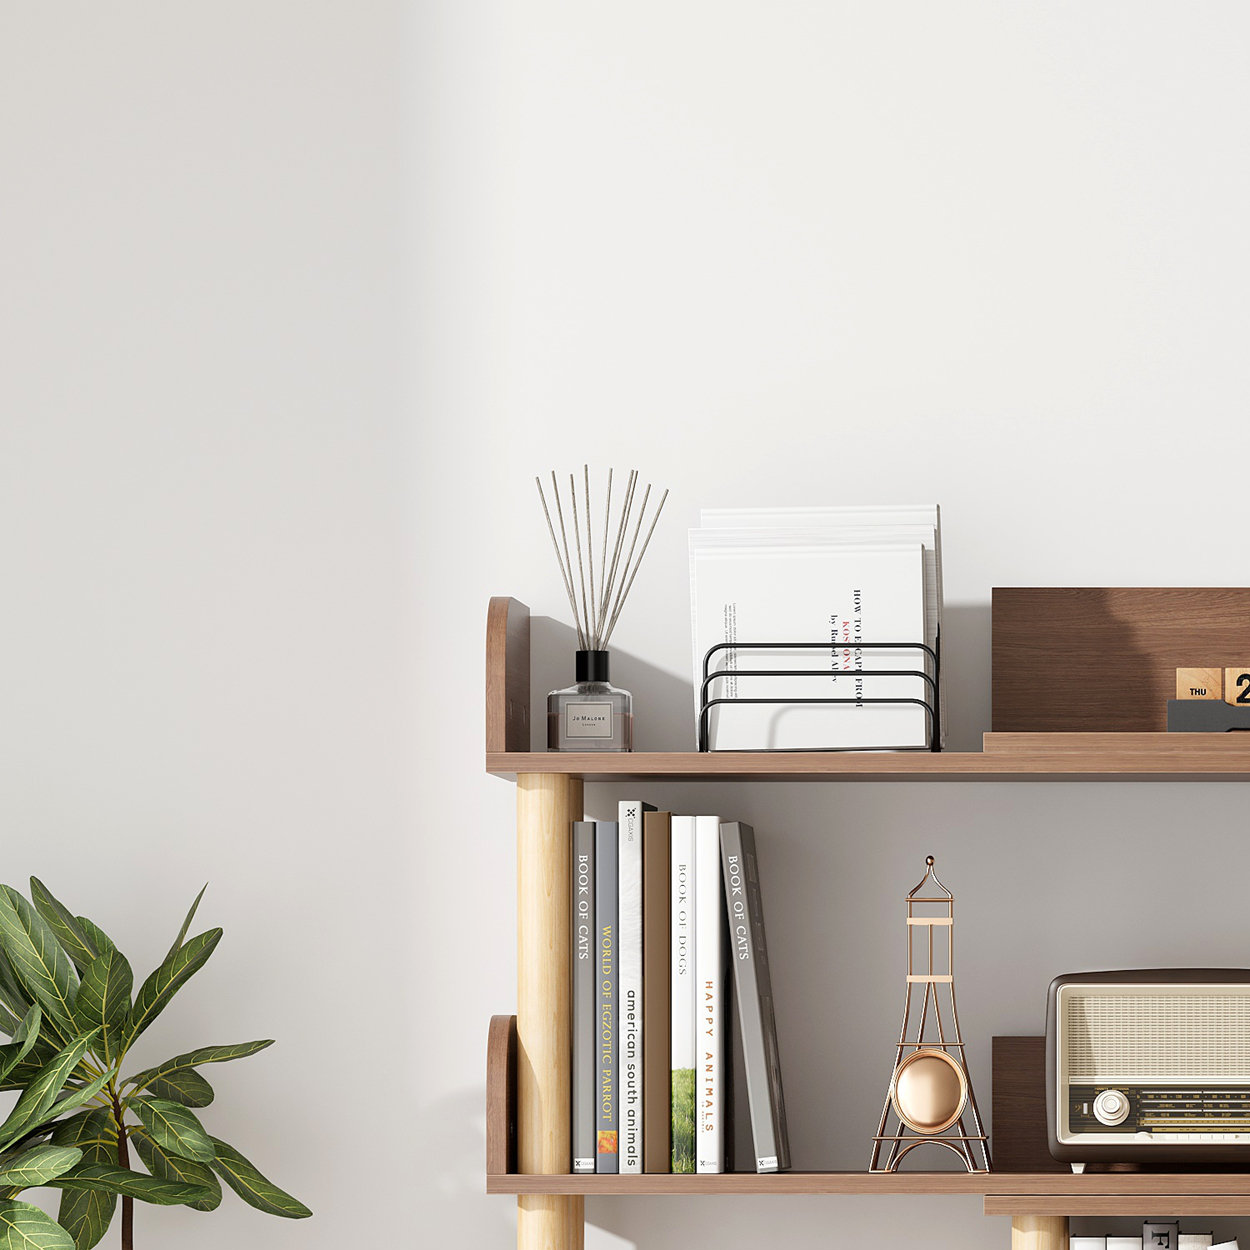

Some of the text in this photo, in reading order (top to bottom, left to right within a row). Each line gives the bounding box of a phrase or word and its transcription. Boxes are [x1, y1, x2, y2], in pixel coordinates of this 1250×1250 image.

[828, 615, 838, 626] by
[853, 589, 861, 614] HOW
[854, 617, 862, 632] TO
[842, 621, 850, 670] KOSONA
[854, 636, 863, 676] ECAP
[1189, 688, 1207, 696] THU
[578, 855, 589, 959] BOOK OF CATS
[678, 864, 687, 975] BOOK OF DOGS
[728, 855, 749, 960] BOOK OF CATS
[602, 925, 612, 1122] WORLD OF EGZOTIC PARROT
[705, 980, 714, 1133] HAPPY ANIMALS
[627, 990, 638, 1166] american south animals
